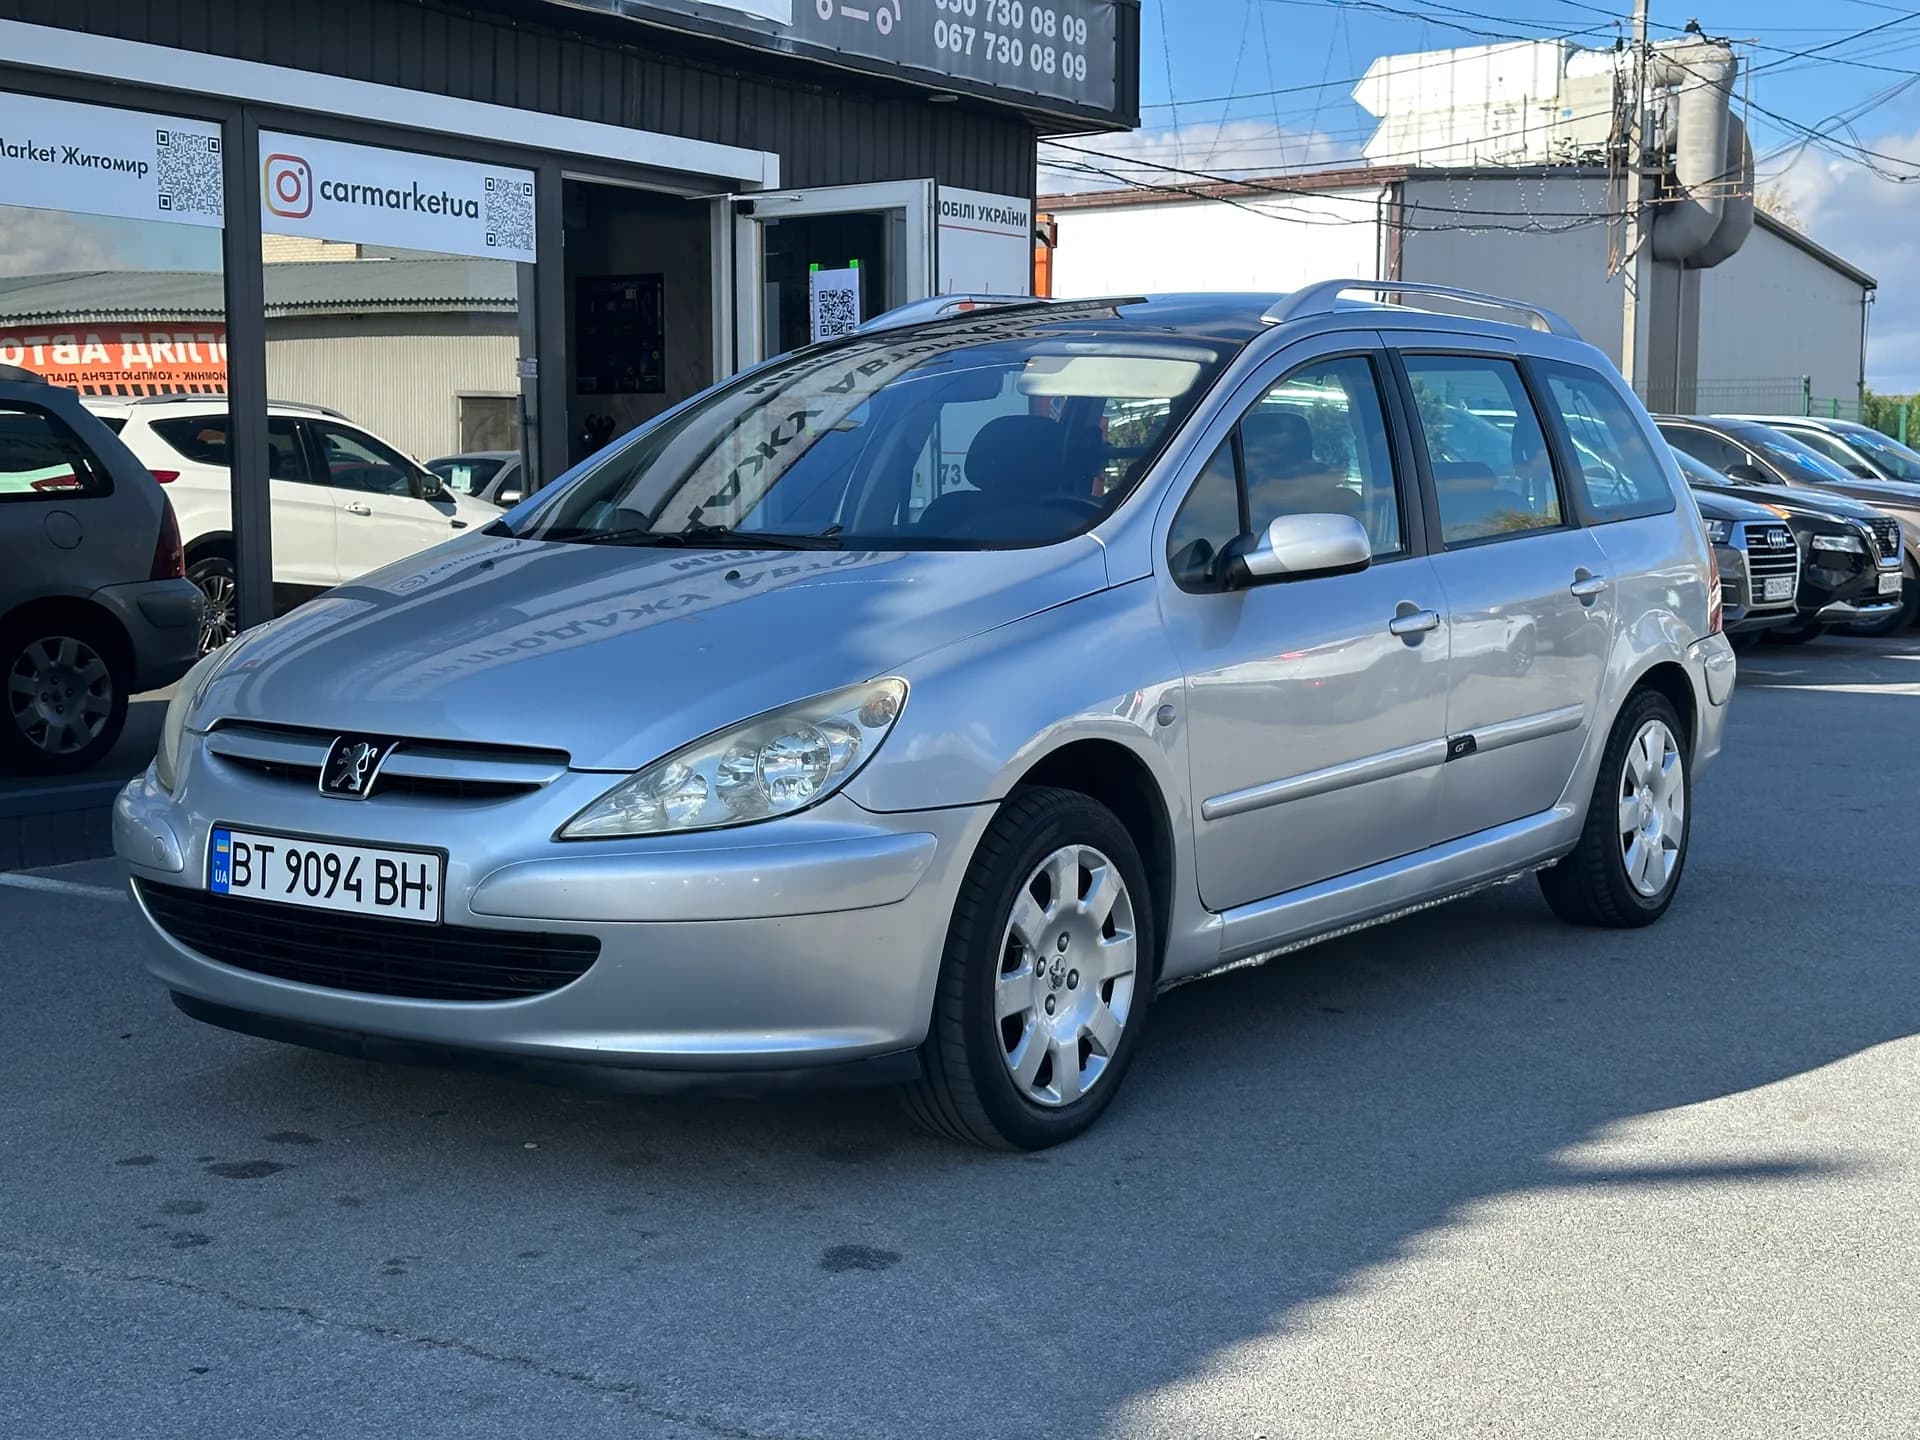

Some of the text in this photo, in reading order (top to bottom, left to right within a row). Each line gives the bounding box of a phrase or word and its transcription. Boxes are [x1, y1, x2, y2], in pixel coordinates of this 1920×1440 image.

[1030, 6, 1056, 37] 08
[1062, 14, 1087, 45] 09
[934, 19, 1087, 82] 067 730 08 09
[61, 145, 149, 179] Житомир
[320, 180, 479, 219] carmarketua
[978, 206, 1027, 228] УКРАЇНИ
[215, 841, 426, 910] UA BT 9094 BH
